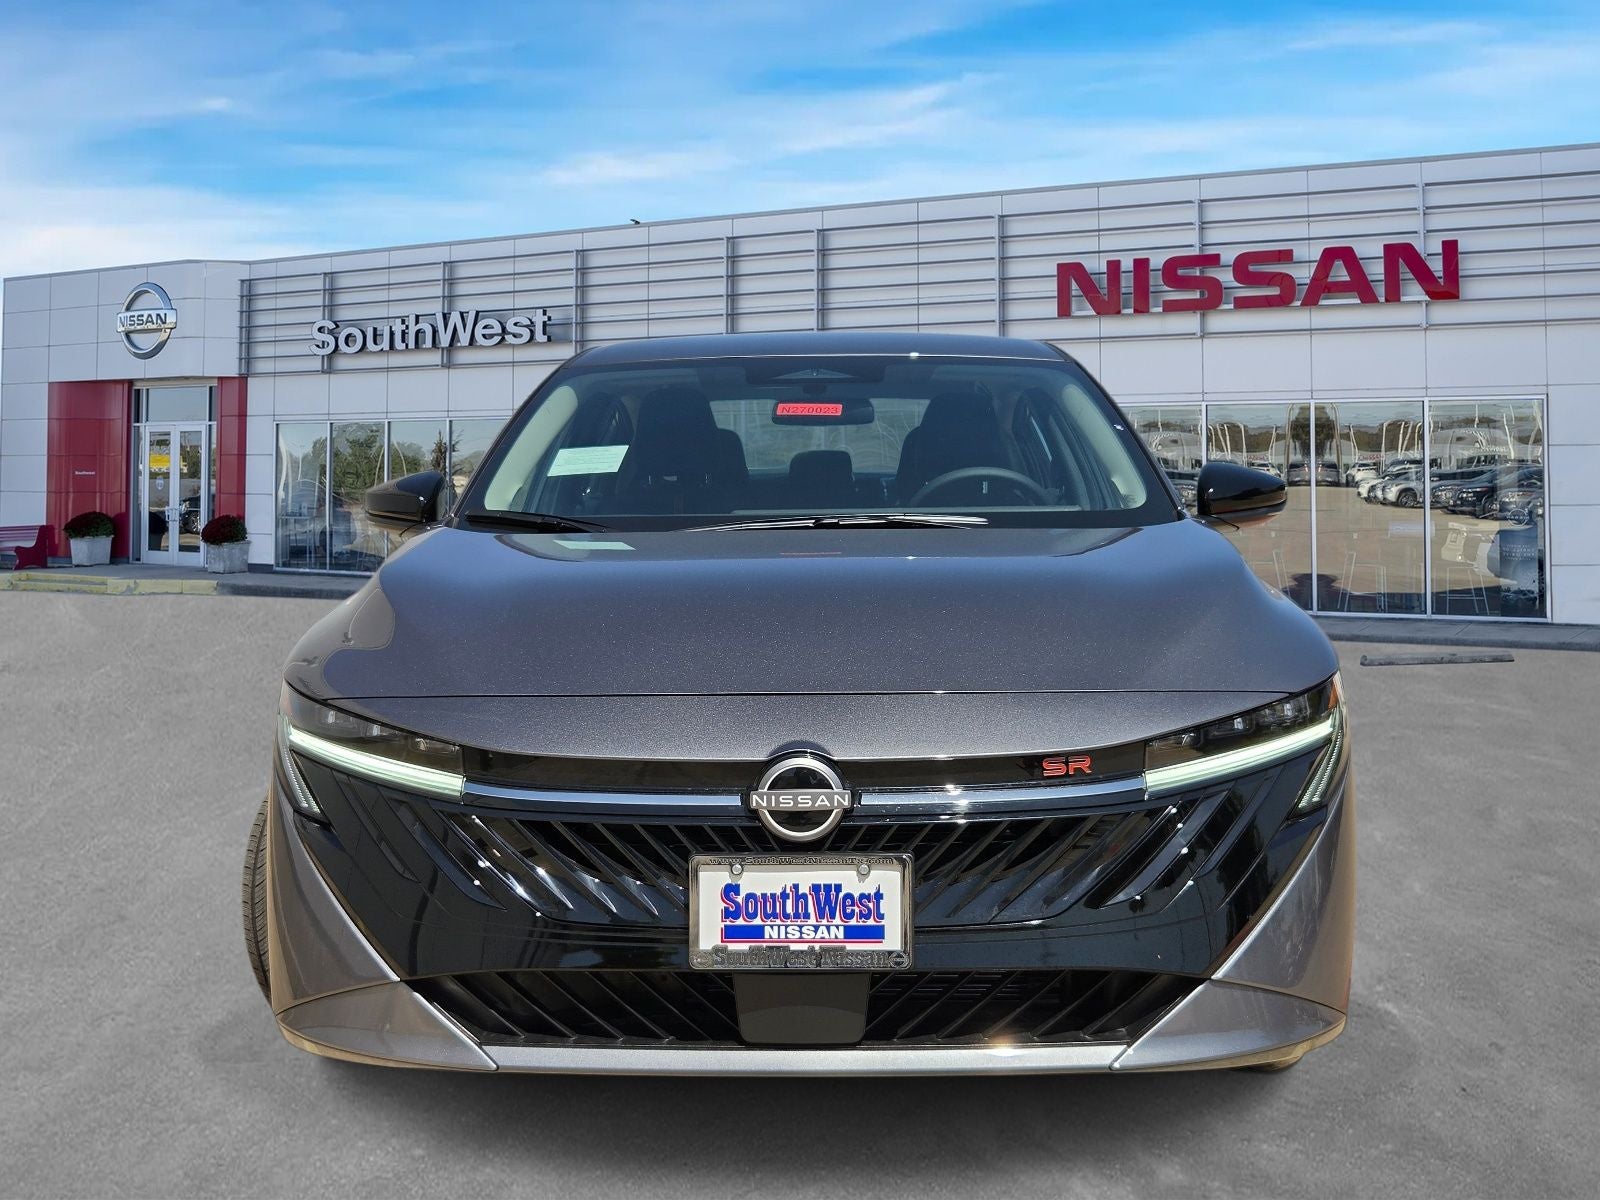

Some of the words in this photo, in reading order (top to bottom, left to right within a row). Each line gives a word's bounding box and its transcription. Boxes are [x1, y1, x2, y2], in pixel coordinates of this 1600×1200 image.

[1057, 239, 1460, 318] NISSAN
[119, 312, 168, 328] NISSAN
[309, 309, 552, 356] SouthWest
[780, 405, 840, 414] N270023
[1043, 755, 1092, 777] SR
[752, 794, 849, 807] NISSAN
[721, 883, 885, 923] SouthWest
[764, 925, 844, 939] NISSAN
